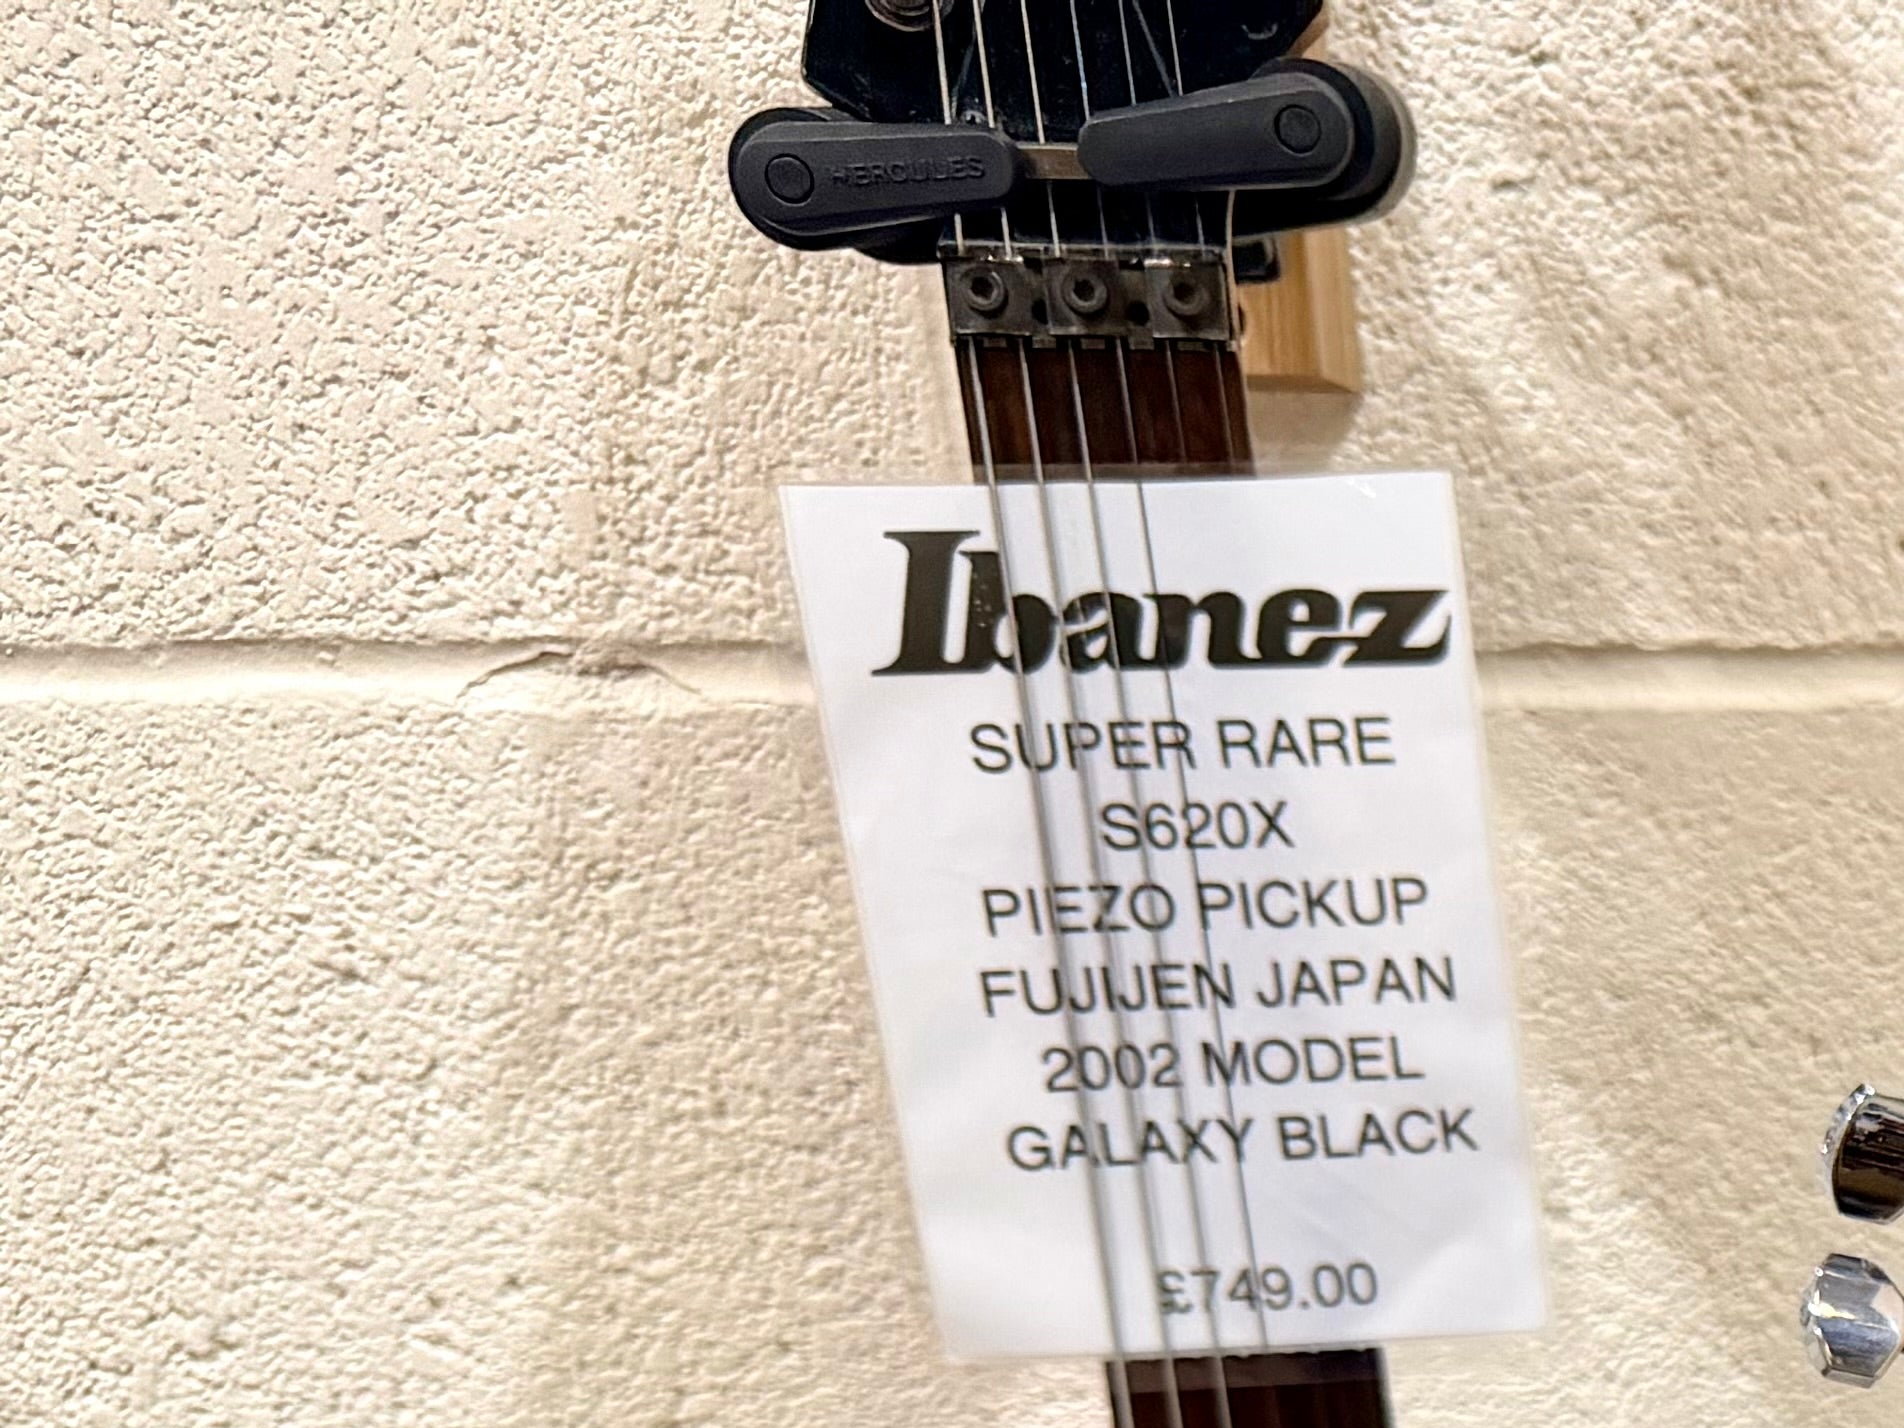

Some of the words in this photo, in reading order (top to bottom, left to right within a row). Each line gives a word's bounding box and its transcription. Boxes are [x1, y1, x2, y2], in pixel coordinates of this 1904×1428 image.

[828, 156, 985, 188] HERCULES
[871, 530, 1453, 677] Ibanez
[969, 721, 1197, 774] SUPER
[1216, 715, 1396, 767] RARE
[1099, 800, 1296, 852] S620X
[982, 885, 1175, 938] PIEZO
[1197, 877, 1429, 930] PICKUP
[979, 962, 1237, 1018] FUJIJEN
[1256, 955, 1457, 1009] JAPAN
[1042, 1041, 1183, 1093] 2002
[1201, 1036, 1426, 1086] MODEL
[1006, 1117, 1253, 1172] GALAXY
[1277, 1108, 1479, 1162] BLACK
[1157, 1262, 1379, 1316] £749.00
